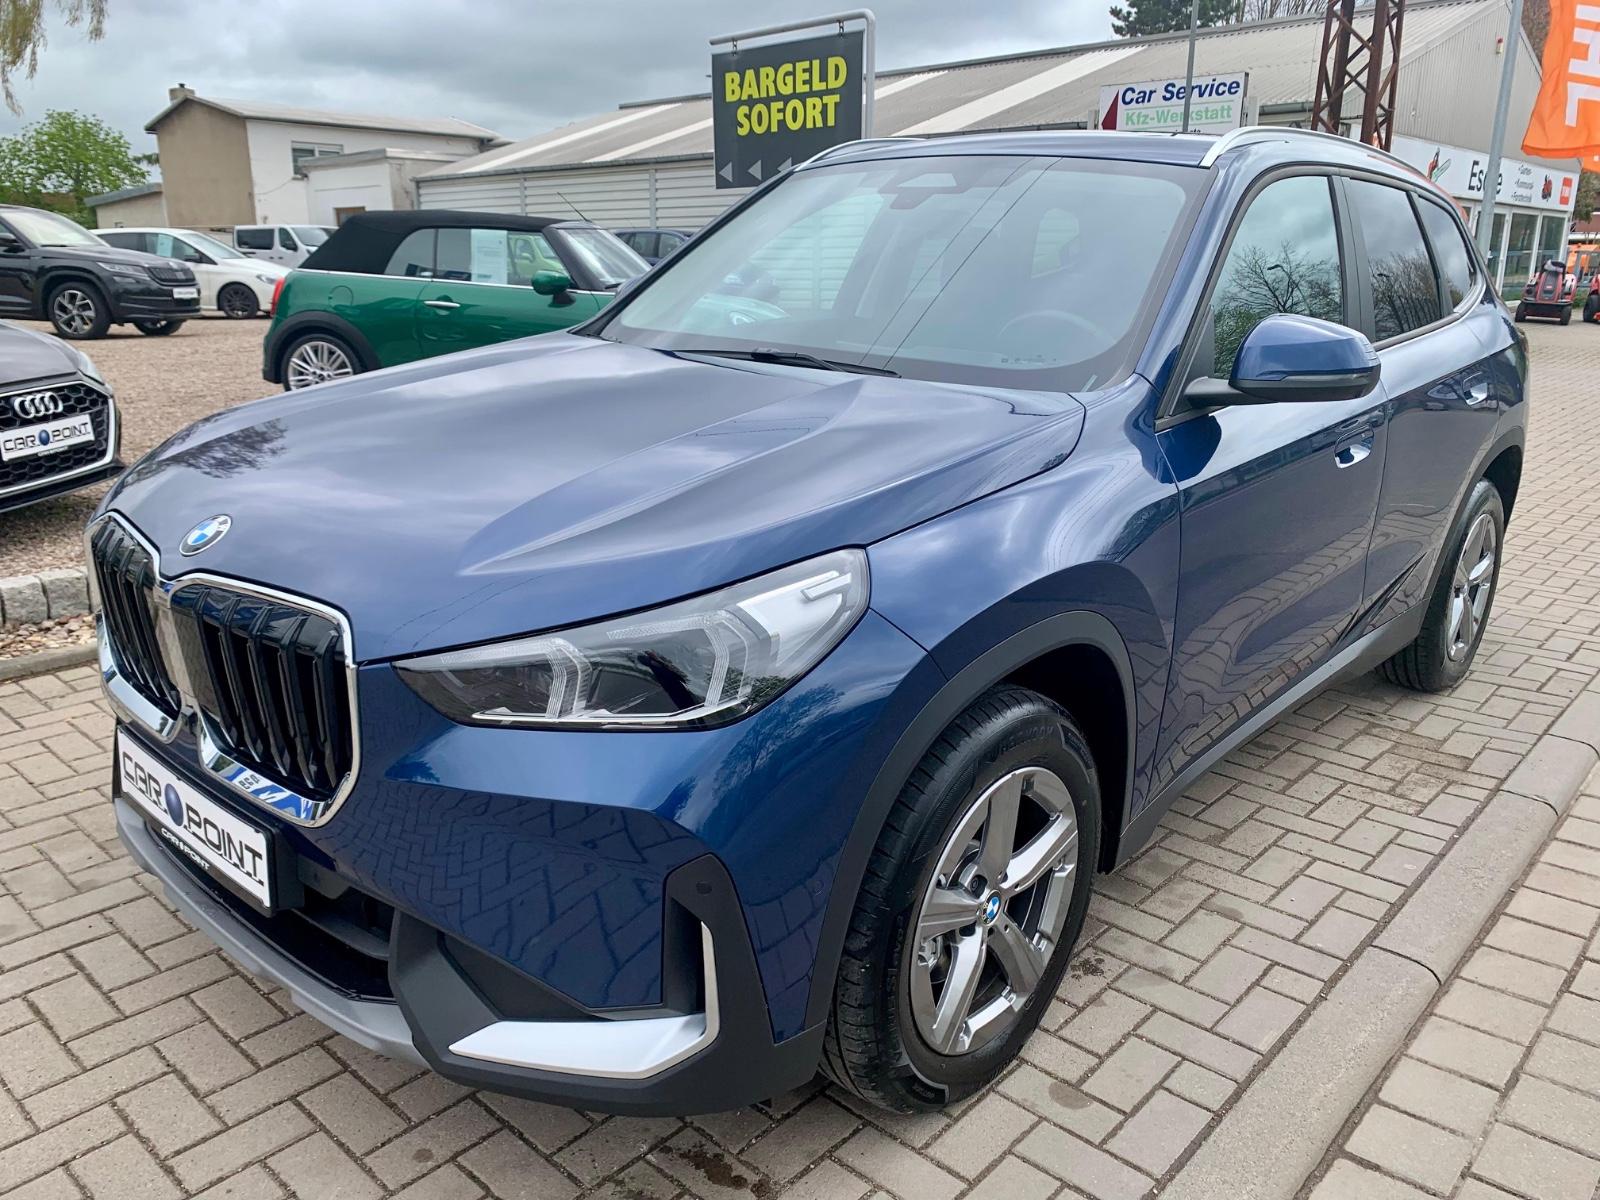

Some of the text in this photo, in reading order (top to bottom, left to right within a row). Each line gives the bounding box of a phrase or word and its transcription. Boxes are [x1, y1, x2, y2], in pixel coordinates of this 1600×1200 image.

[724, 56, 848, 103] BARGELD
[1121, 78, 1240, 106] Car Service
[736, 94, 840, 136] SOFORT
[3, 434, 36, 451] CAR
[51, 422, 89, 441] POINT
[122, 751, 263, 882] CAR POINT
